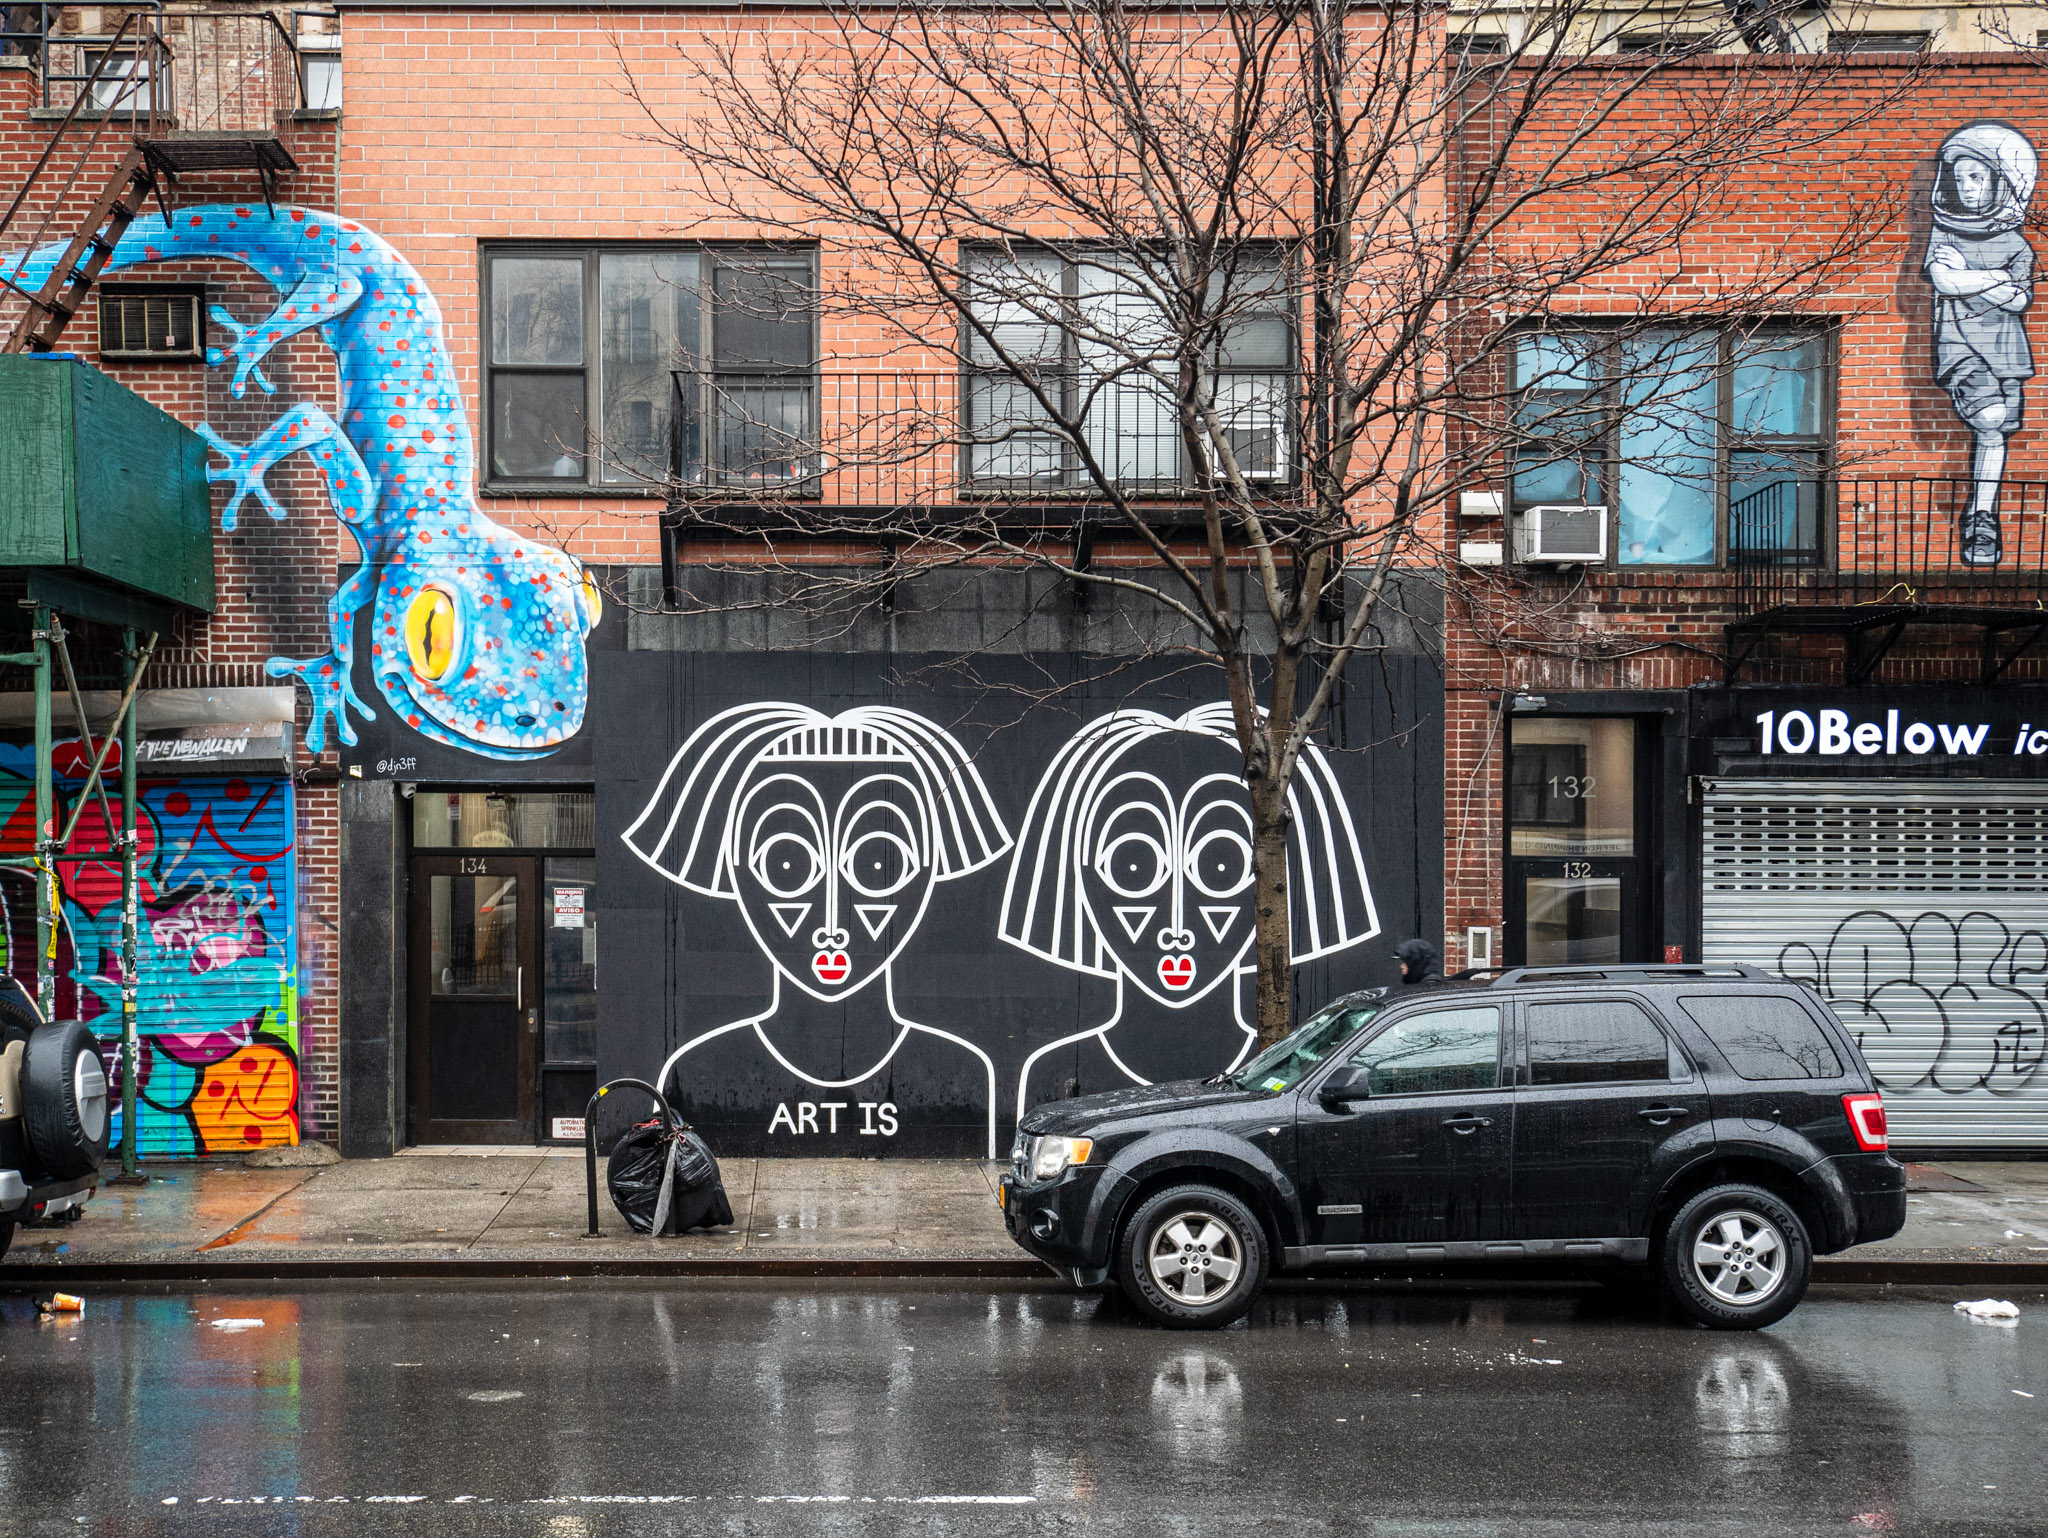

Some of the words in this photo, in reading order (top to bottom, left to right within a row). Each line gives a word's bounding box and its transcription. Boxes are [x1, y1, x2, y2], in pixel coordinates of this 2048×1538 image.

[1756, 709, 1990, 755] 10Below
[376, 757, 417, 775] @djn3ff
[1548, 775, 1597, 799] 132
[460, 857, 488, 874] 134
[1563, 862, 1592, 878] 132
[768, 1102, 848, 1135] ART
[858, 1102, 899, 1136] IS
[1738, 1197, 1800, 1248] ENERAL
